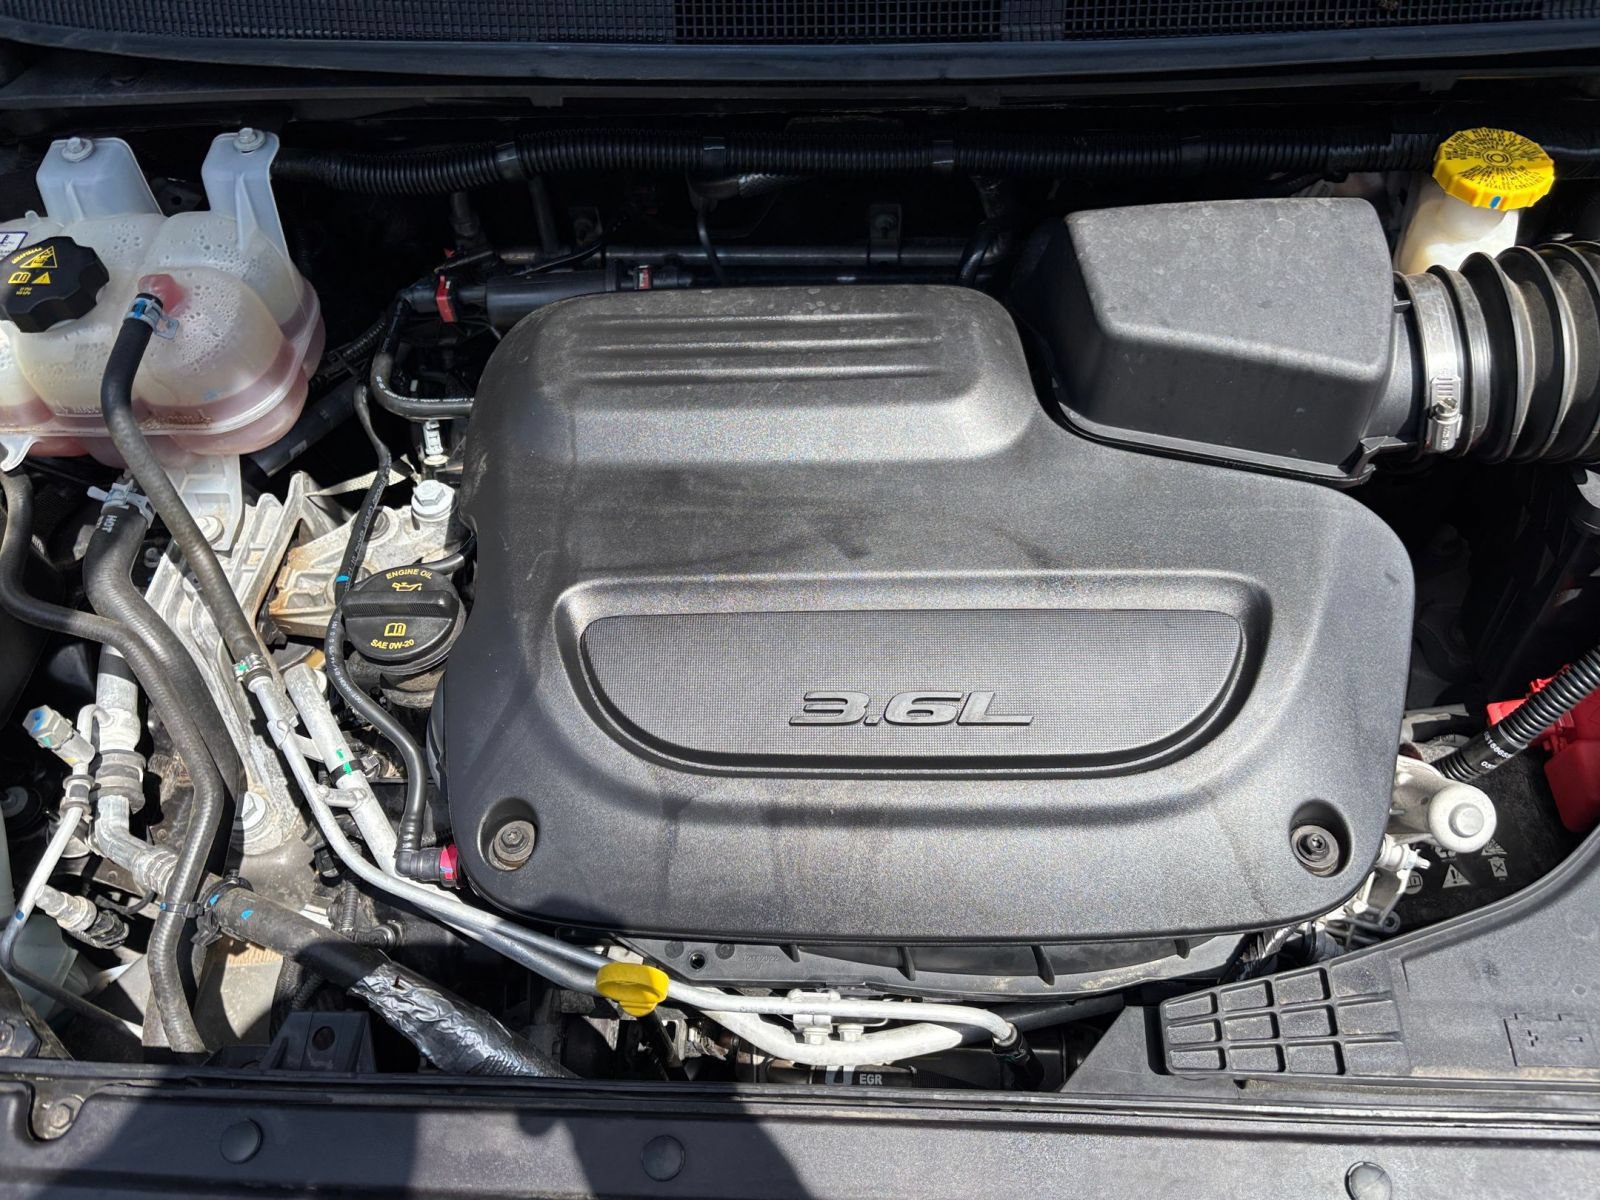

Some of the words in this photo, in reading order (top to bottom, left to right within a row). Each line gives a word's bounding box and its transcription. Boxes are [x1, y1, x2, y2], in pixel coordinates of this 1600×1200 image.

[101, 515, 117, 533] HOT
[385, 568, 420, 580] ENGINE
[420, 570, 433, 580] OIL
[370, 639, 388, 649] SAE
[388, 639, 415, 649] 0W-20
[788, 690, 1035, 726] 3.6L
[859, 1073, 883, 1085] EGR
